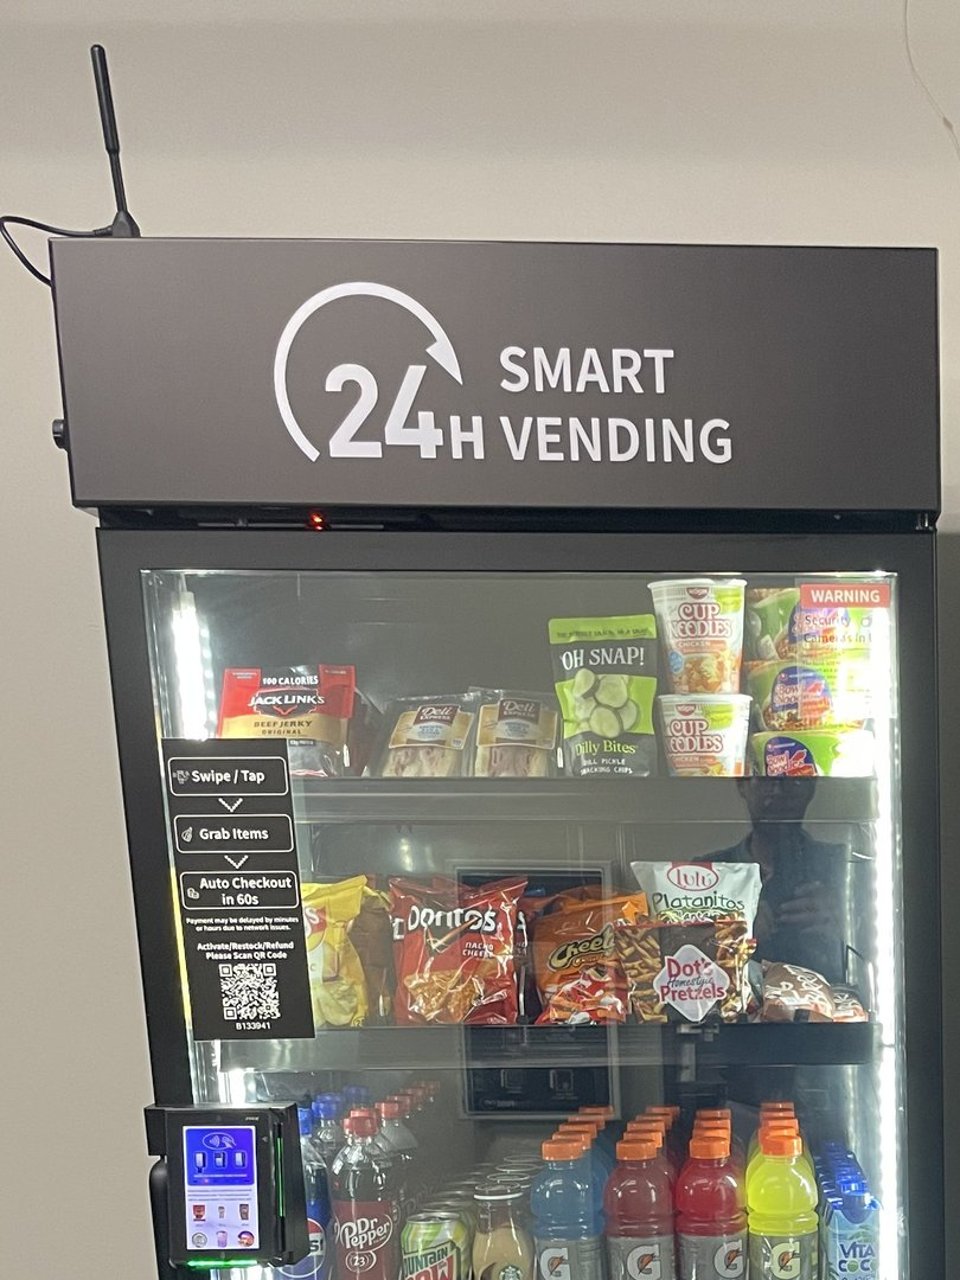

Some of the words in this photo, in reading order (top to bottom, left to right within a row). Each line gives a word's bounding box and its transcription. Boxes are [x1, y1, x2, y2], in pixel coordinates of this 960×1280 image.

[500, 346, 675, 394] SMART
[324, 362, 485, 460] 24H
[500, 416, 732, 464] VENDING
[811, 589, 880, 603] WARNING
[679, 602, 721, 621] CUP
[562, 649, 585, 671] OH
[588, 646, 645, 666] SNAP!
[262, 677, 277, 685] 100
[278, 675, 319, 685] CALORIES
[248, 696, 283, 706] JACK
[279, 720, 313, 728] JERKY
[670, 719, 709, 737] CUP
[603, 739, 636, 754] Bites
[191, 769, 231, 785] Swipe
[240, 769, 265, 784] Tap
[199, 827, 231, 841] Grab
[232, 827, 269, 840] Items
[200, 877, 230, 889] Auto
[231, 876, 292, 889] Checkout
[221, 893, 235, 905] in
[236, 893, 259, 905] 60s
[652, 889, 745, 910] Platanitos
[197, 941, 294, 951] Activate/Restock/Refund
[205, 951, 232, 960] Please
[233, 951, 252, 959] Scan
[253, 951, 266, 960] QR
[266, 951, 287, 959] Code
[665, 957, 714, 978] Dot's
[659, 985, 727, 1002] Pretzels
[357, 1217, 378, 1231] Dr
[340, 1218, 391, 1250] Pepper
[840, 1243, 876, 1257] VITA
[352, 1256, 367, 1267] 23
